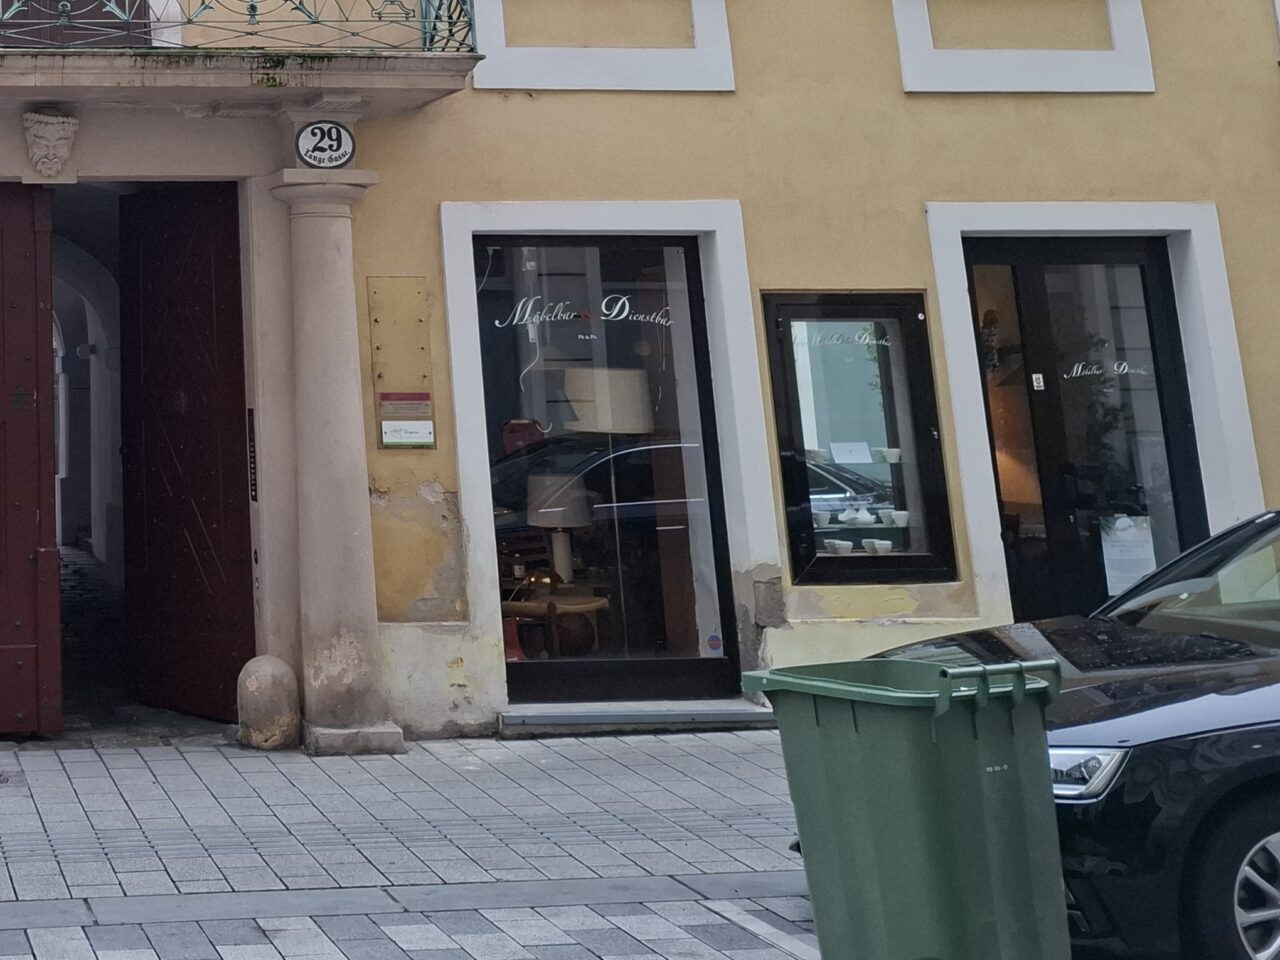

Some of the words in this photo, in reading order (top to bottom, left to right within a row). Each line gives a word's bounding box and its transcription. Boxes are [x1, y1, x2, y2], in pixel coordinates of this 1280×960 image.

[311, 126, 342, 153] 29
[304, 149, 325, 164] Lange
[494, 295, 578, 328] Möbelbar
[600, 294, 674, 327] Dienstbar
